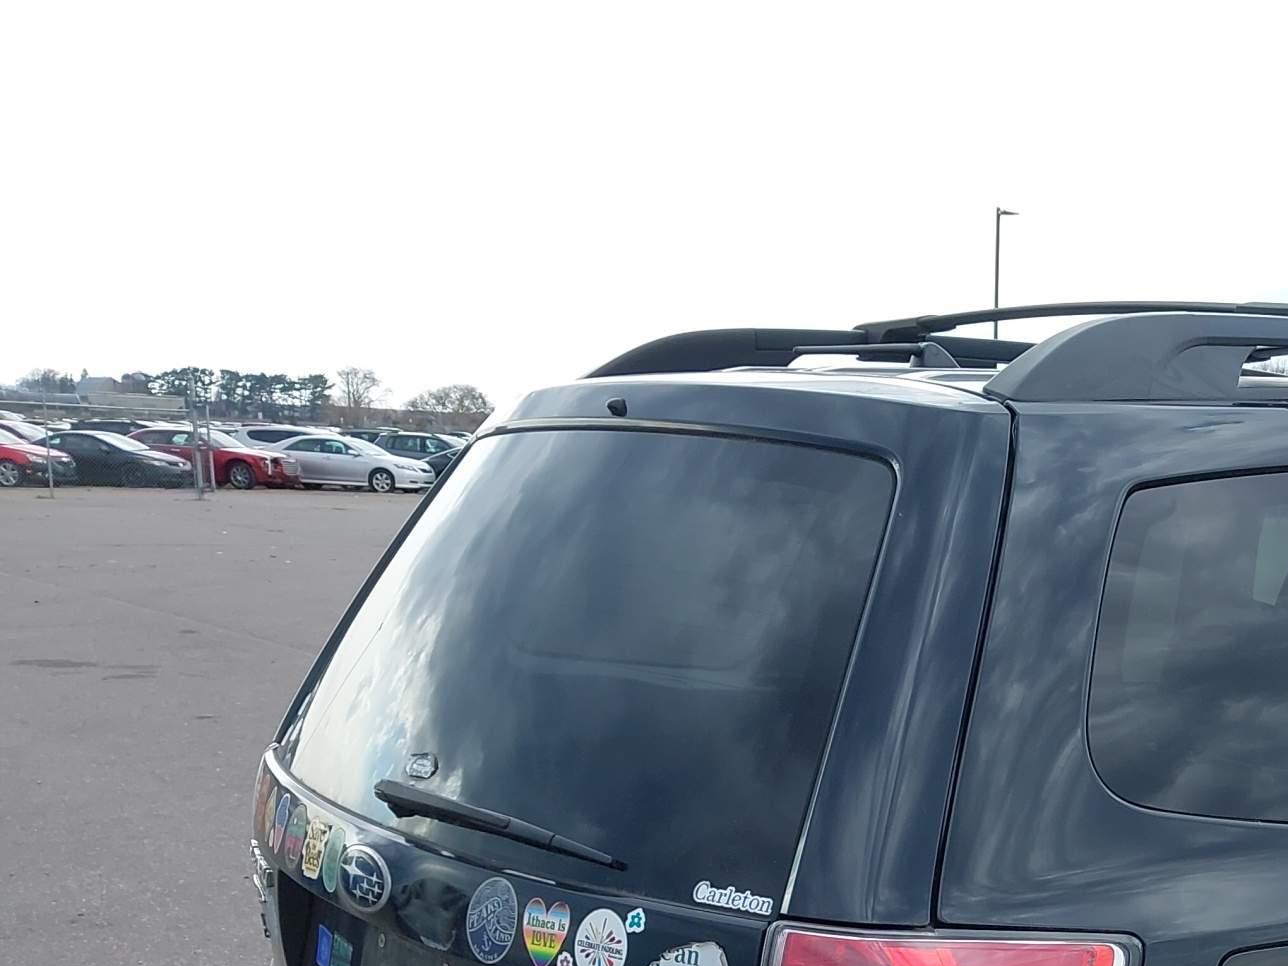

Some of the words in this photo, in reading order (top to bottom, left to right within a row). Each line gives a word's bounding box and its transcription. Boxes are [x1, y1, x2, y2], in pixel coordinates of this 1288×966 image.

[693, 880, 773, 915] Carleton
[526, 912, 556, 931] Ithaca
[557, 918, 566, 932] is
[531, 930, 556, 949] LOVE
